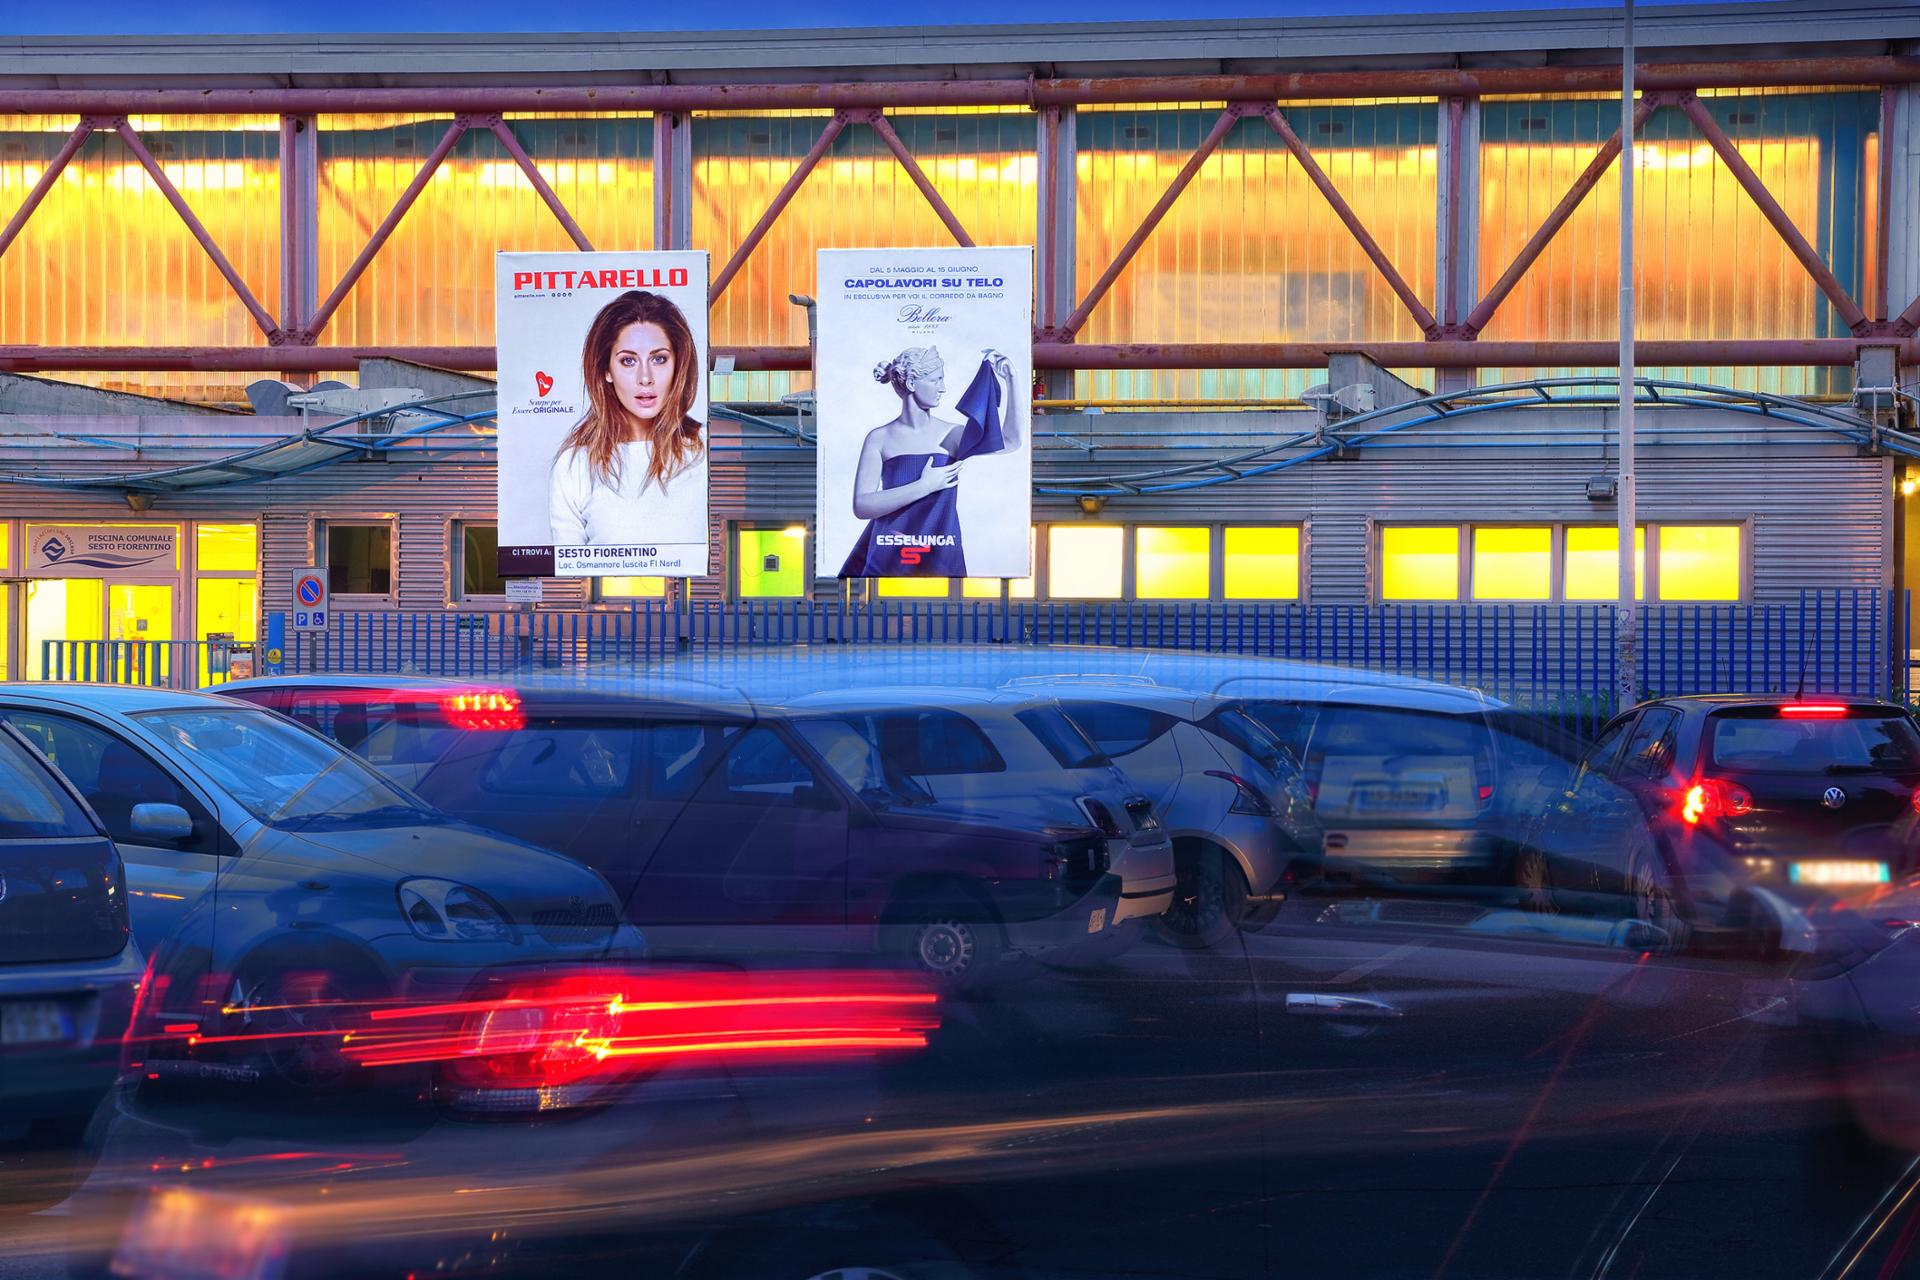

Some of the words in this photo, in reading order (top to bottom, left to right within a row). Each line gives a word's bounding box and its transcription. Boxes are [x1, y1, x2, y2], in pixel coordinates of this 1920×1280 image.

[947, 265, 979, 273] GIUGNO
[513, 268, 689, 291] PITTARELLO
[844, 278, 937, 288] CAPOLAVORI
[941, 278, 962, 288] SU
[966, 277, 1004, 287] TELO
[896, 303, 951, 323] Bellora
[88, 534, 124, 542] PISCINA
[126, 534, 173, 542] COMUNALE
[876, 534, 955, 546] ESSELUNGA
[558, 548, 591, 558] SESTO
[593, 547, 657, 558] FIORENTINO
[558, 561, 575, 569] Loc.
[576, 561, 620, 569] Osmannoro
[622, 560, 648, 569] (uscita
[650, 560, 657, 568] FI
[659, 559, 681, 568] Nord)
[298, 614, 306, 625] P
